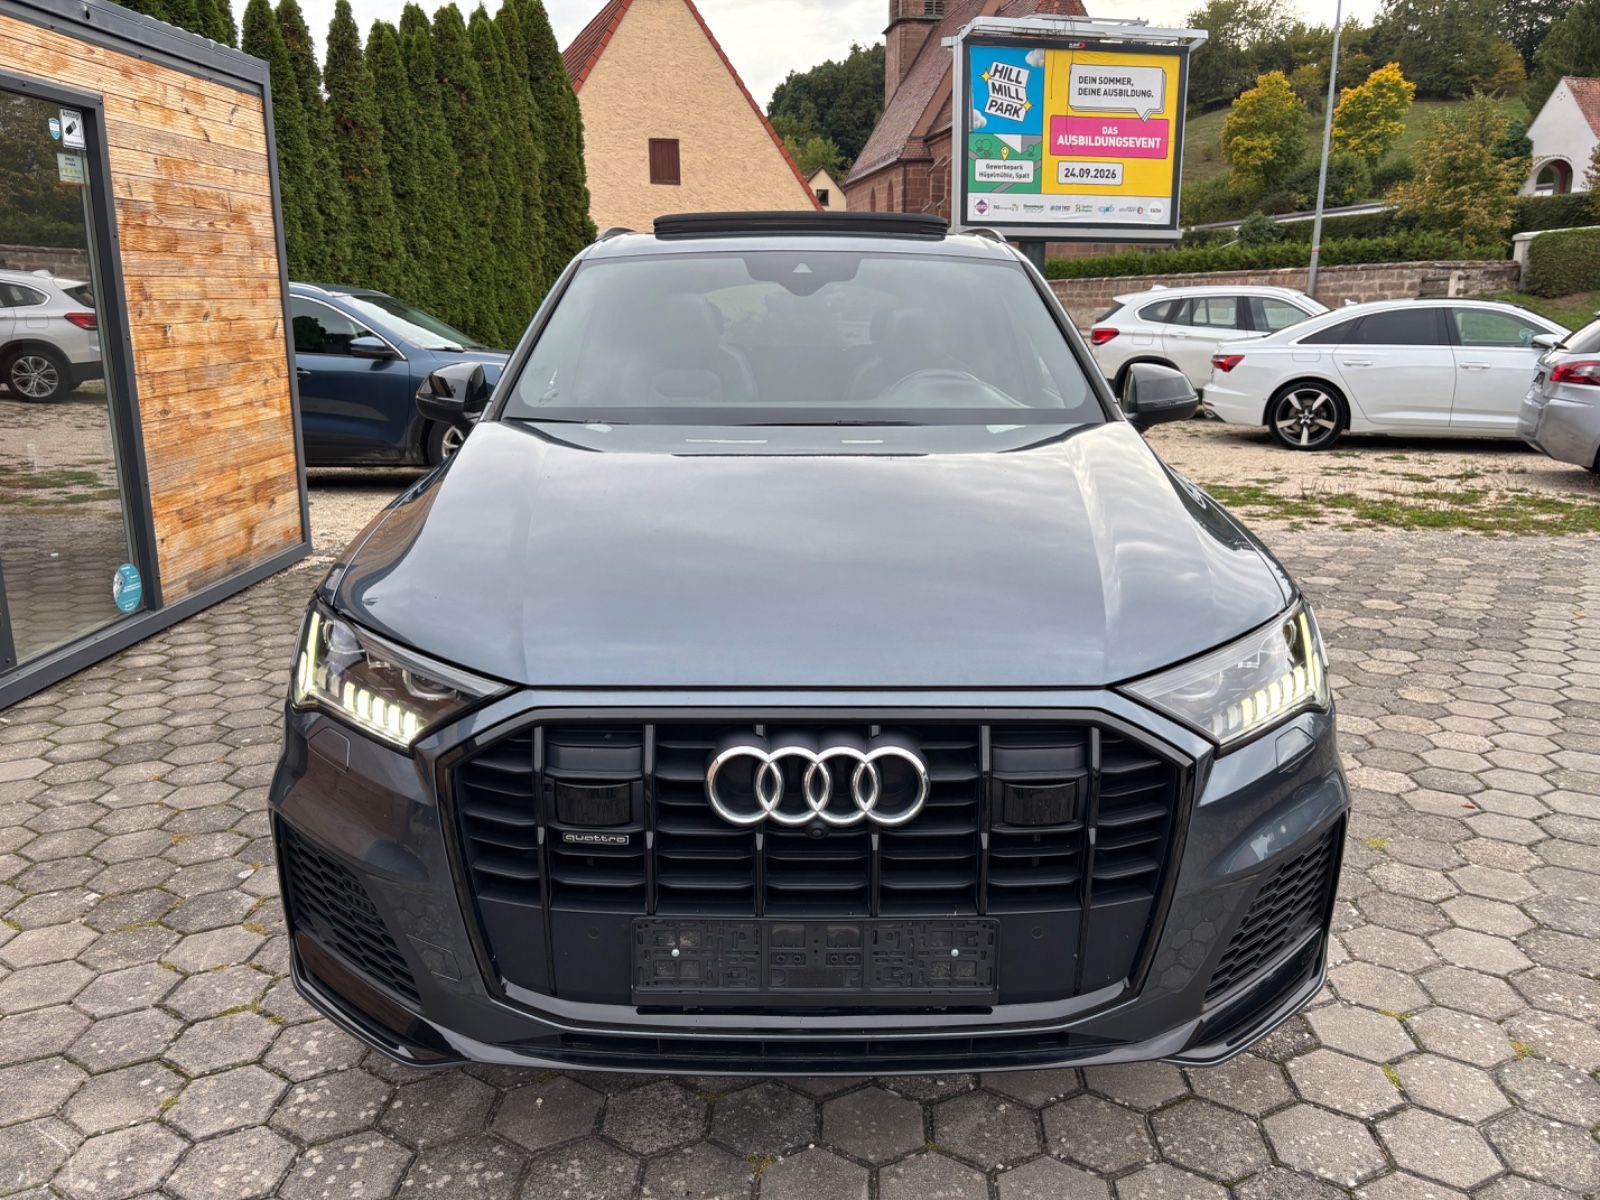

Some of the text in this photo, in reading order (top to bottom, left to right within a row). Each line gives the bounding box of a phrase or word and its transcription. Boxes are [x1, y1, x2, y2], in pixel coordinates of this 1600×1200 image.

[990, 63, 1022, 84] HILL
[1078, 75, 1134, 87] DEIN SOMMER,
[991, 82, 1023, 102] MILL
[1077, 87, 1154, 98] DEINE AUSBILDUNG.
[988, 99, 1022, 119] PARK
[1101, 126, 1118, 135] DAS
[1057, 134, 1162, 149] AUSBILDUNGSEVENT
[1063, 167, 1117, 179] 24.09.2026
[565, 833, 626, 843] quattro
